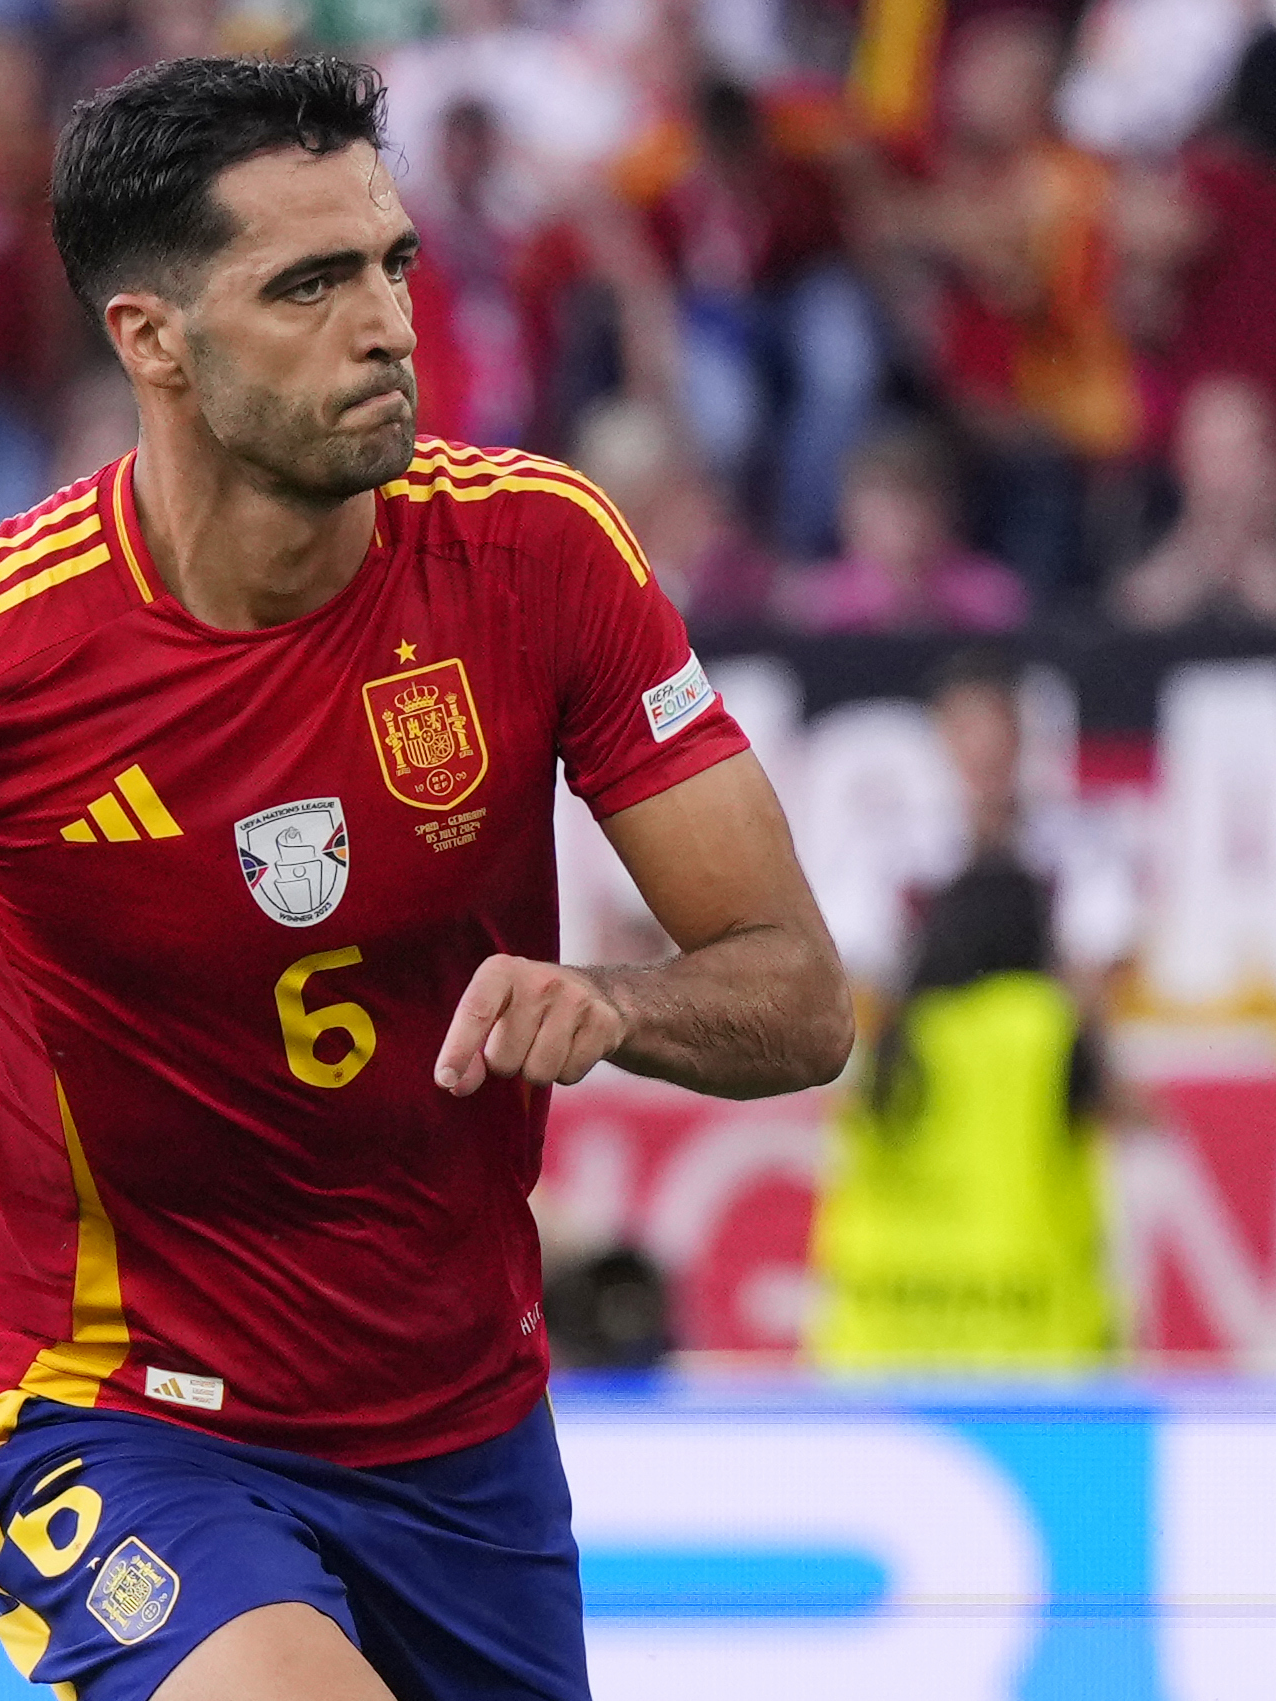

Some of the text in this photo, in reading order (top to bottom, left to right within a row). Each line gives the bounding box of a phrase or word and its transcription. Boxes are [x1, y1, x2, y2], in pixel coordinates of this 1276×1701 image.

[649, 684, 673, 706] UEFA
[240, 801, 335, 831] UEFA NATIONS LEAGUE
[439, 826, 457, 840] JULY
[279, 912, 313, 922] WINNER
[274, 945, 376, 1088] 6
[7, 1458, 102, 1577] 6
